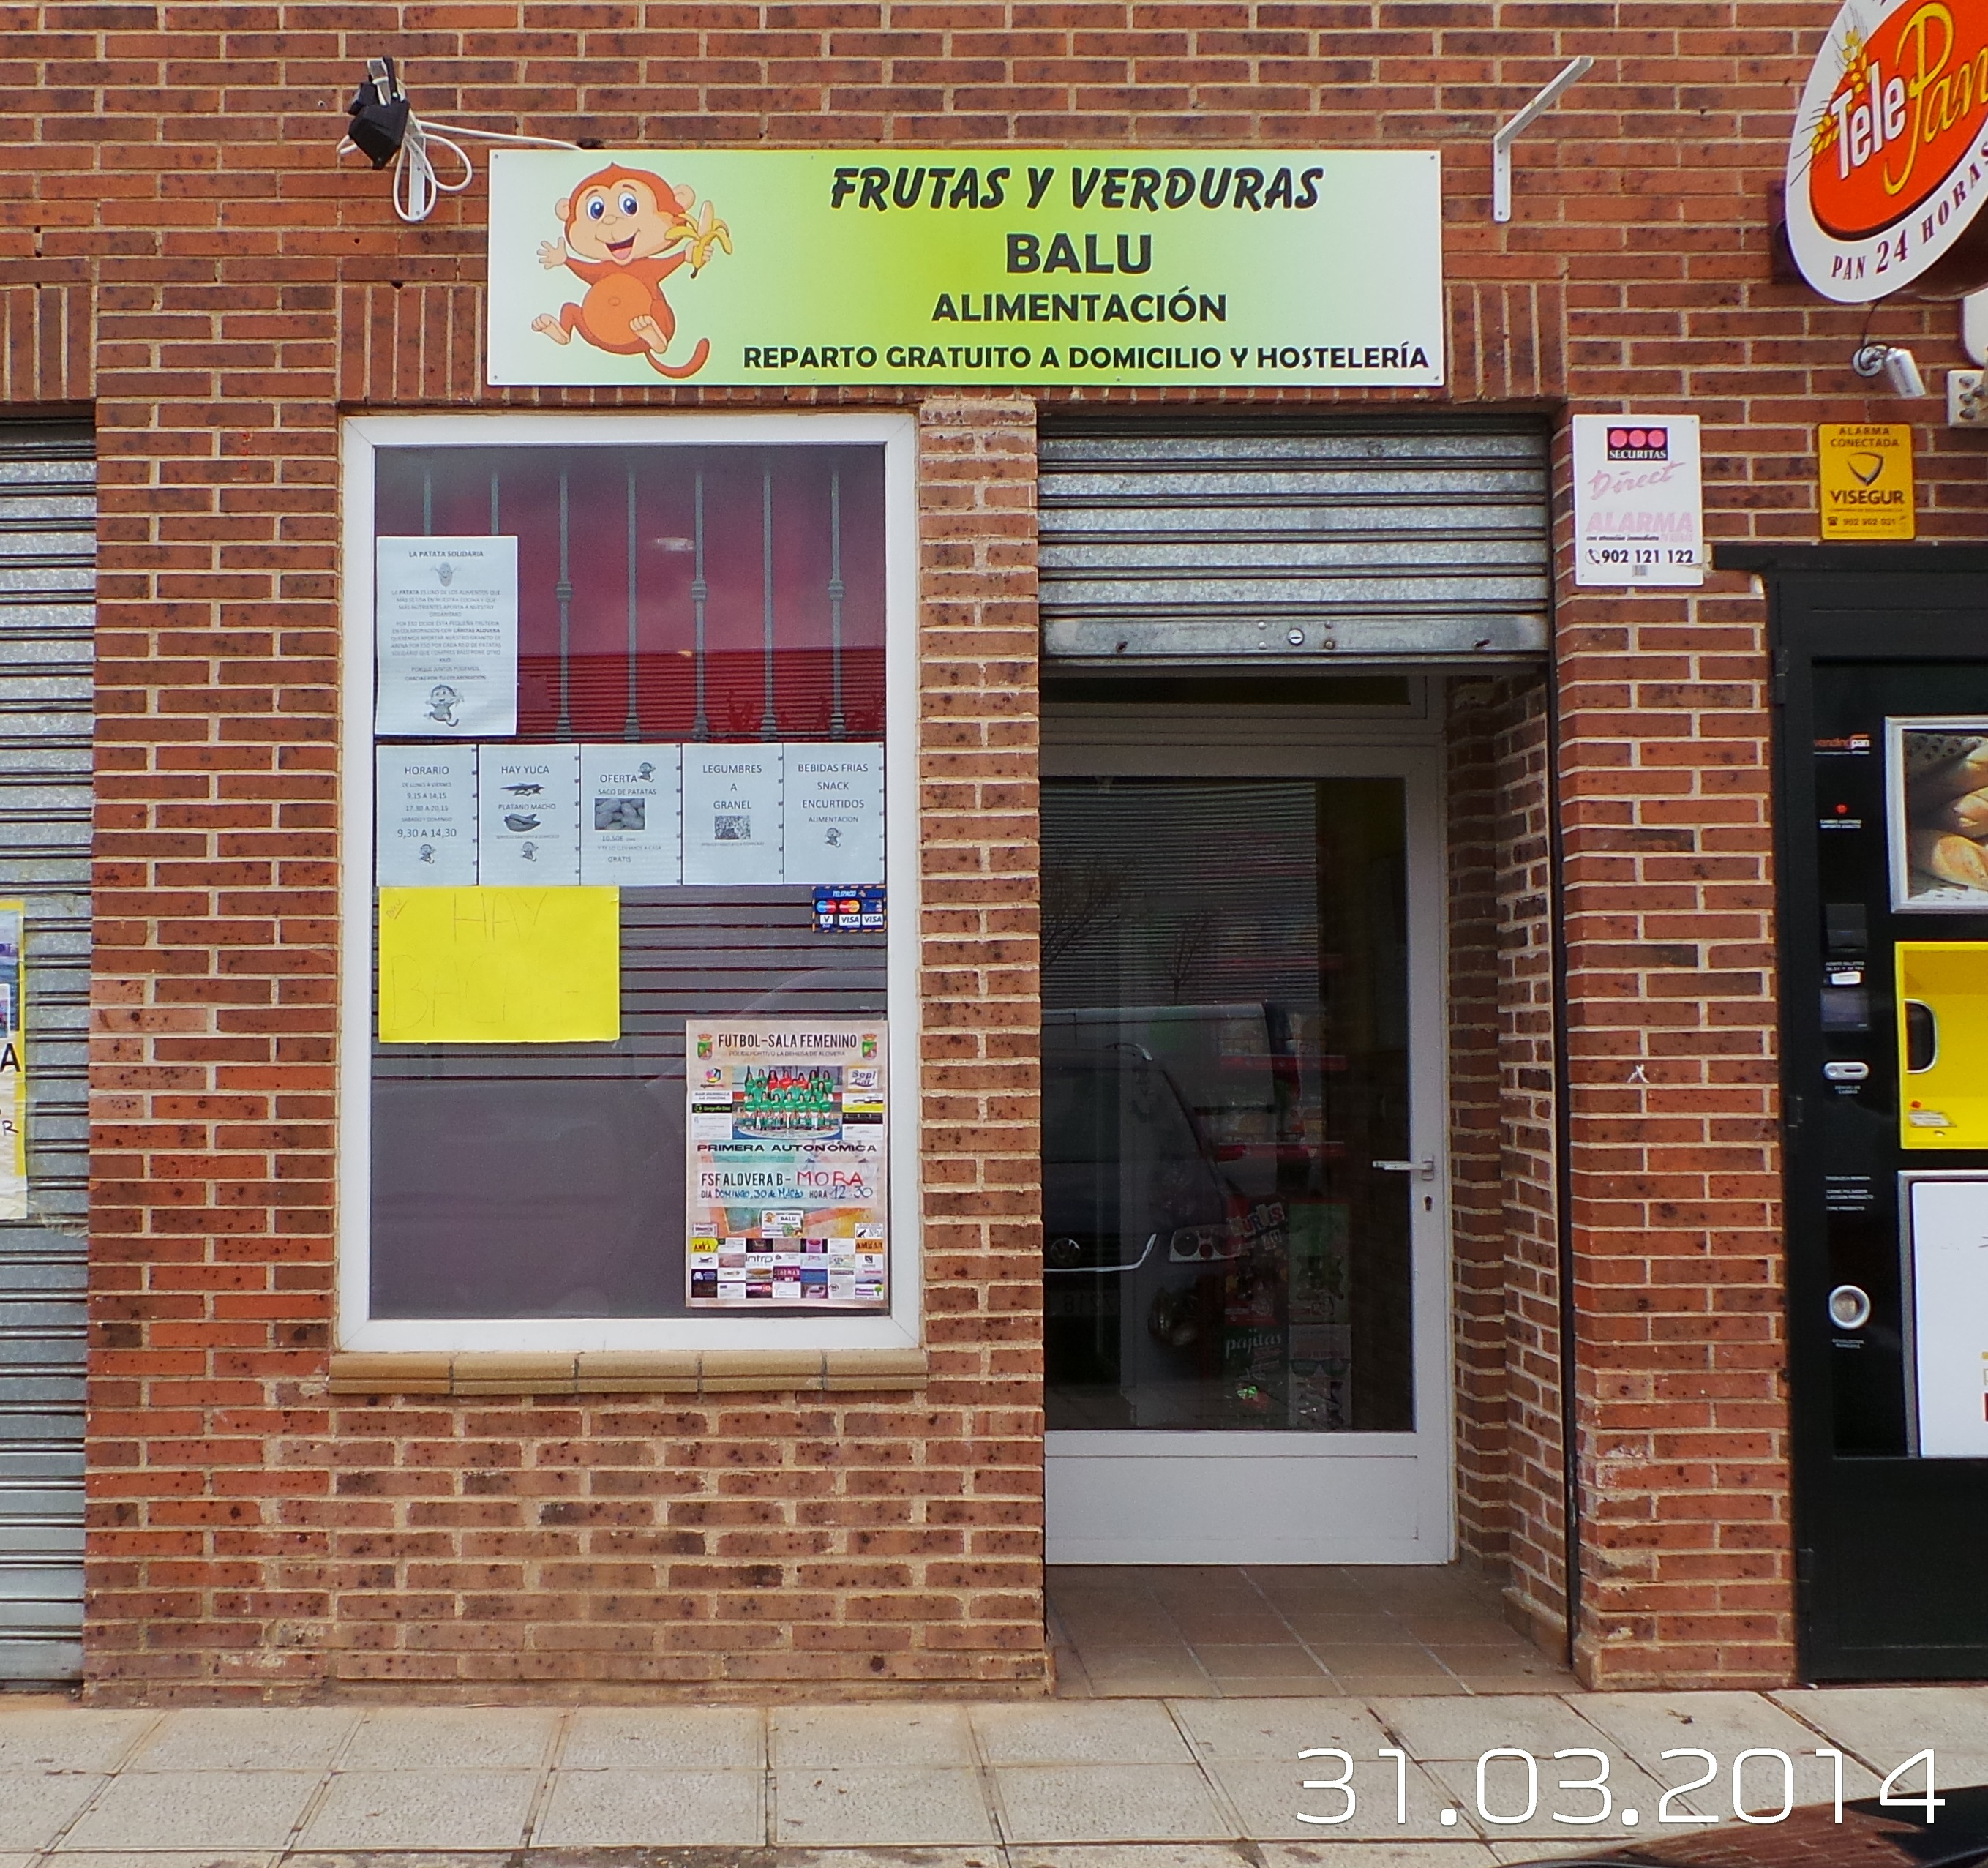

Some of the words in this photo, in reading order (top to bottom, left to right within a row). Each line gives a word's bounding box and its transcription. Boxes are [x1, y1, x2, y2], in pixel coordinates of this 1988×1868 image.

[831, 167, 1010, 211] FRUTAS
[1025, 167, 1053, 211] Y
[1071, 167, 1323, 211] VERDURAS
[1007, 233, 1152, 274] BALU
[1831, 255, 1866, 280] PAN
[1875, 228, 1908, 274] 24
[932, 285, 1226, 323] ALIMENTACIÓN
[743, 346, 877, 370] REPARTO
[885, 346, 1031, 370] GRATUITO
[1041, 346, 1062, 368] A
[1069, 346, 1223, 370] DOMICILIO
[1230, 346, 1250, 368] Y
[1257, 340, 1430, 370] HOSTELERÍA
[1839, 427, 1889, 435] ALARMA
[1830, 438, 1899, 447] CONECTADA
[1609, 449, 1667, 459] SECURITAS
[1587, 461, 1686, 501] Direct
[1830, 490, 1905, 505] VISEGUR
[1585, 511, 1694, 533] ALARMA
[1601, 549, 1629, 563] 902
[1635, 549, 1659, 563] 121
[1667, 549, 1694, 563] 122
[405, 766, 449, 775] HORARIO
[501, 765, 521, 774] HAY
[523, 765, 549, 774] YUCA
[702, 765, 762, 773] LEGUMBRES
[798, 763, 839, 772] BEBIDAS
[841, 763, 869, 772] FRIAS
[600, 774, 638, 783] OFERTA
[730, 783, 737, 791] A
[817, 781, 849, 790] SNACK
[713, 800, 751, 809] GRANEL
[802, 799, 865, 809] ENCURTIDOS
[421, 828, 428, 839] A
[453, 890, 549, 944] HAY
[800, 1034, 858, 1048] FEMENINO
[702, 1173, 721, 1186] FSF
[723, 1173, 773, 1186] ALOVERA
[797, 1171, 864, 1186] MORA
[809, 1190, 828, 1199] HORA
[1226, 1328, 1282, 1359] pajitas
